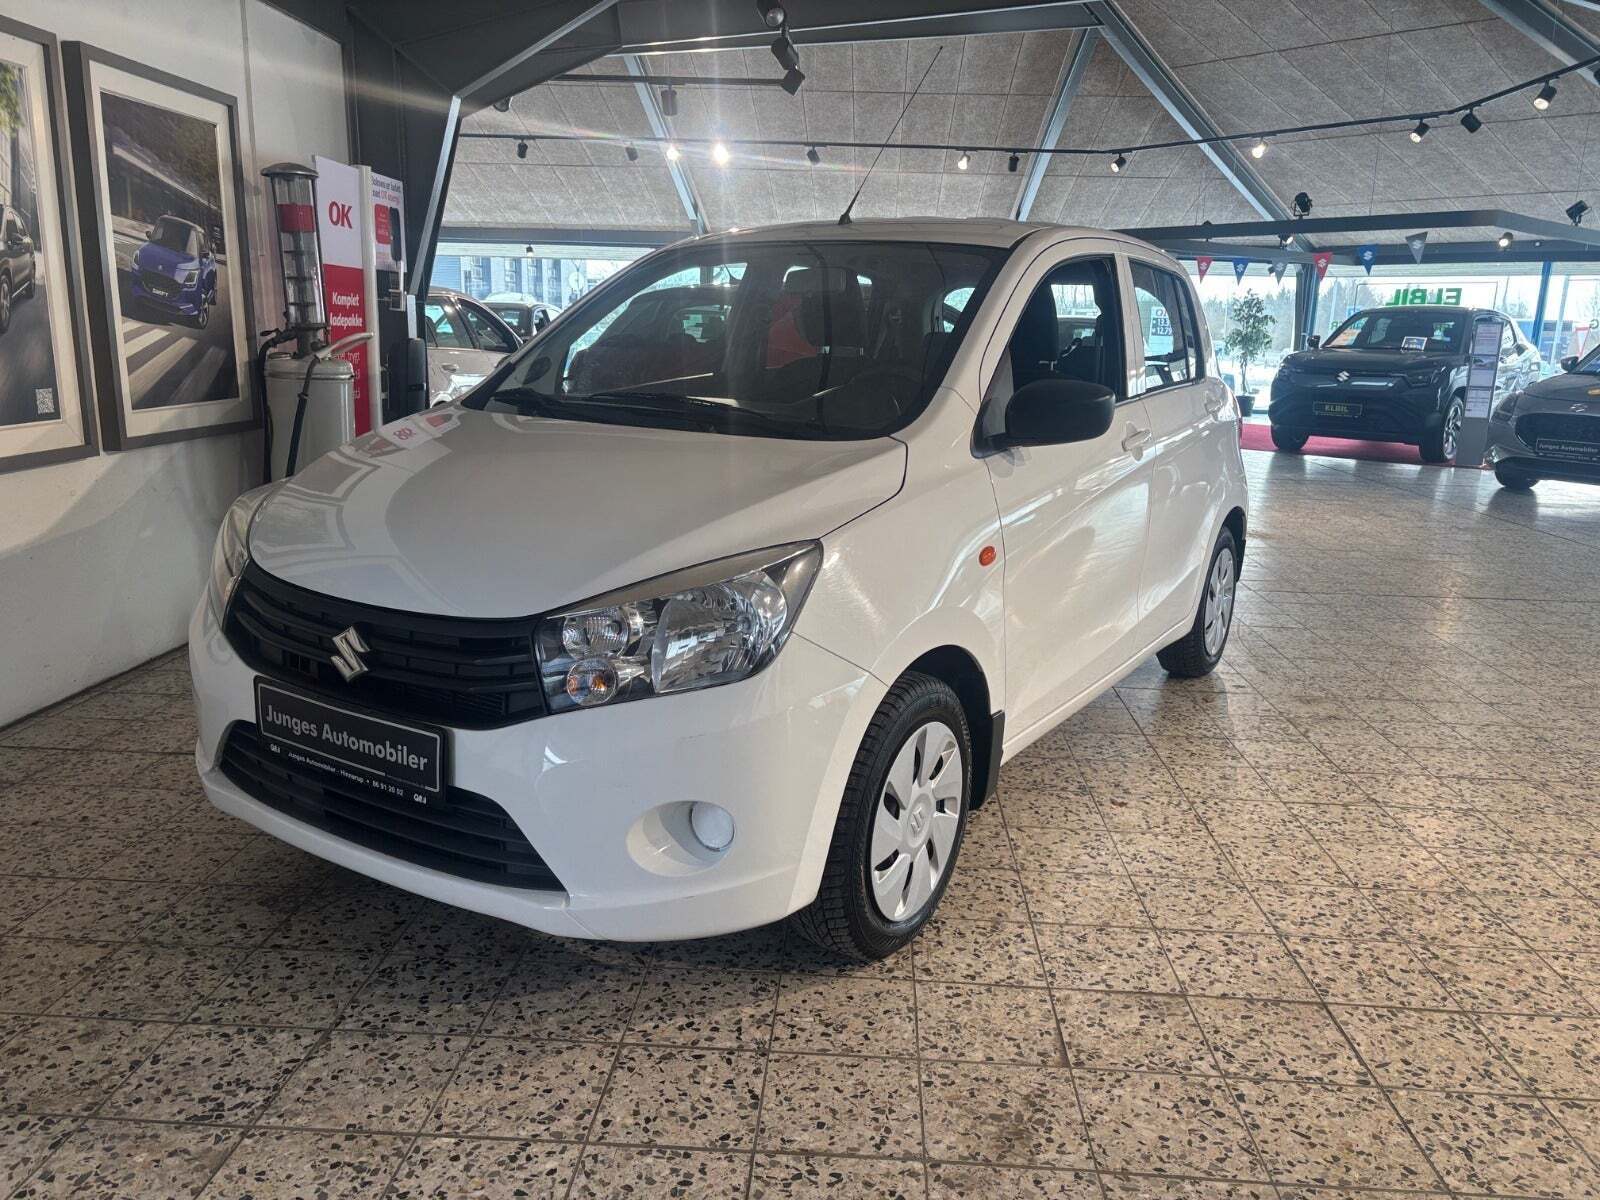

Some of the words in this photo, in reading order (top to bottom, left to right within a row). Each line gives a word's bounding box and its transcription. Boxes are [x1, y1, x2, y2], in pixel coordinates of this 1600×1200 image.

[328, 201, 353, 229] OK
[332, 291, 360, 310] Komplet
[330, 312, 363, 330] ladepakke
[265, 705, 318, 737] Junges
[322, 723, 428, 771] Automobiler
